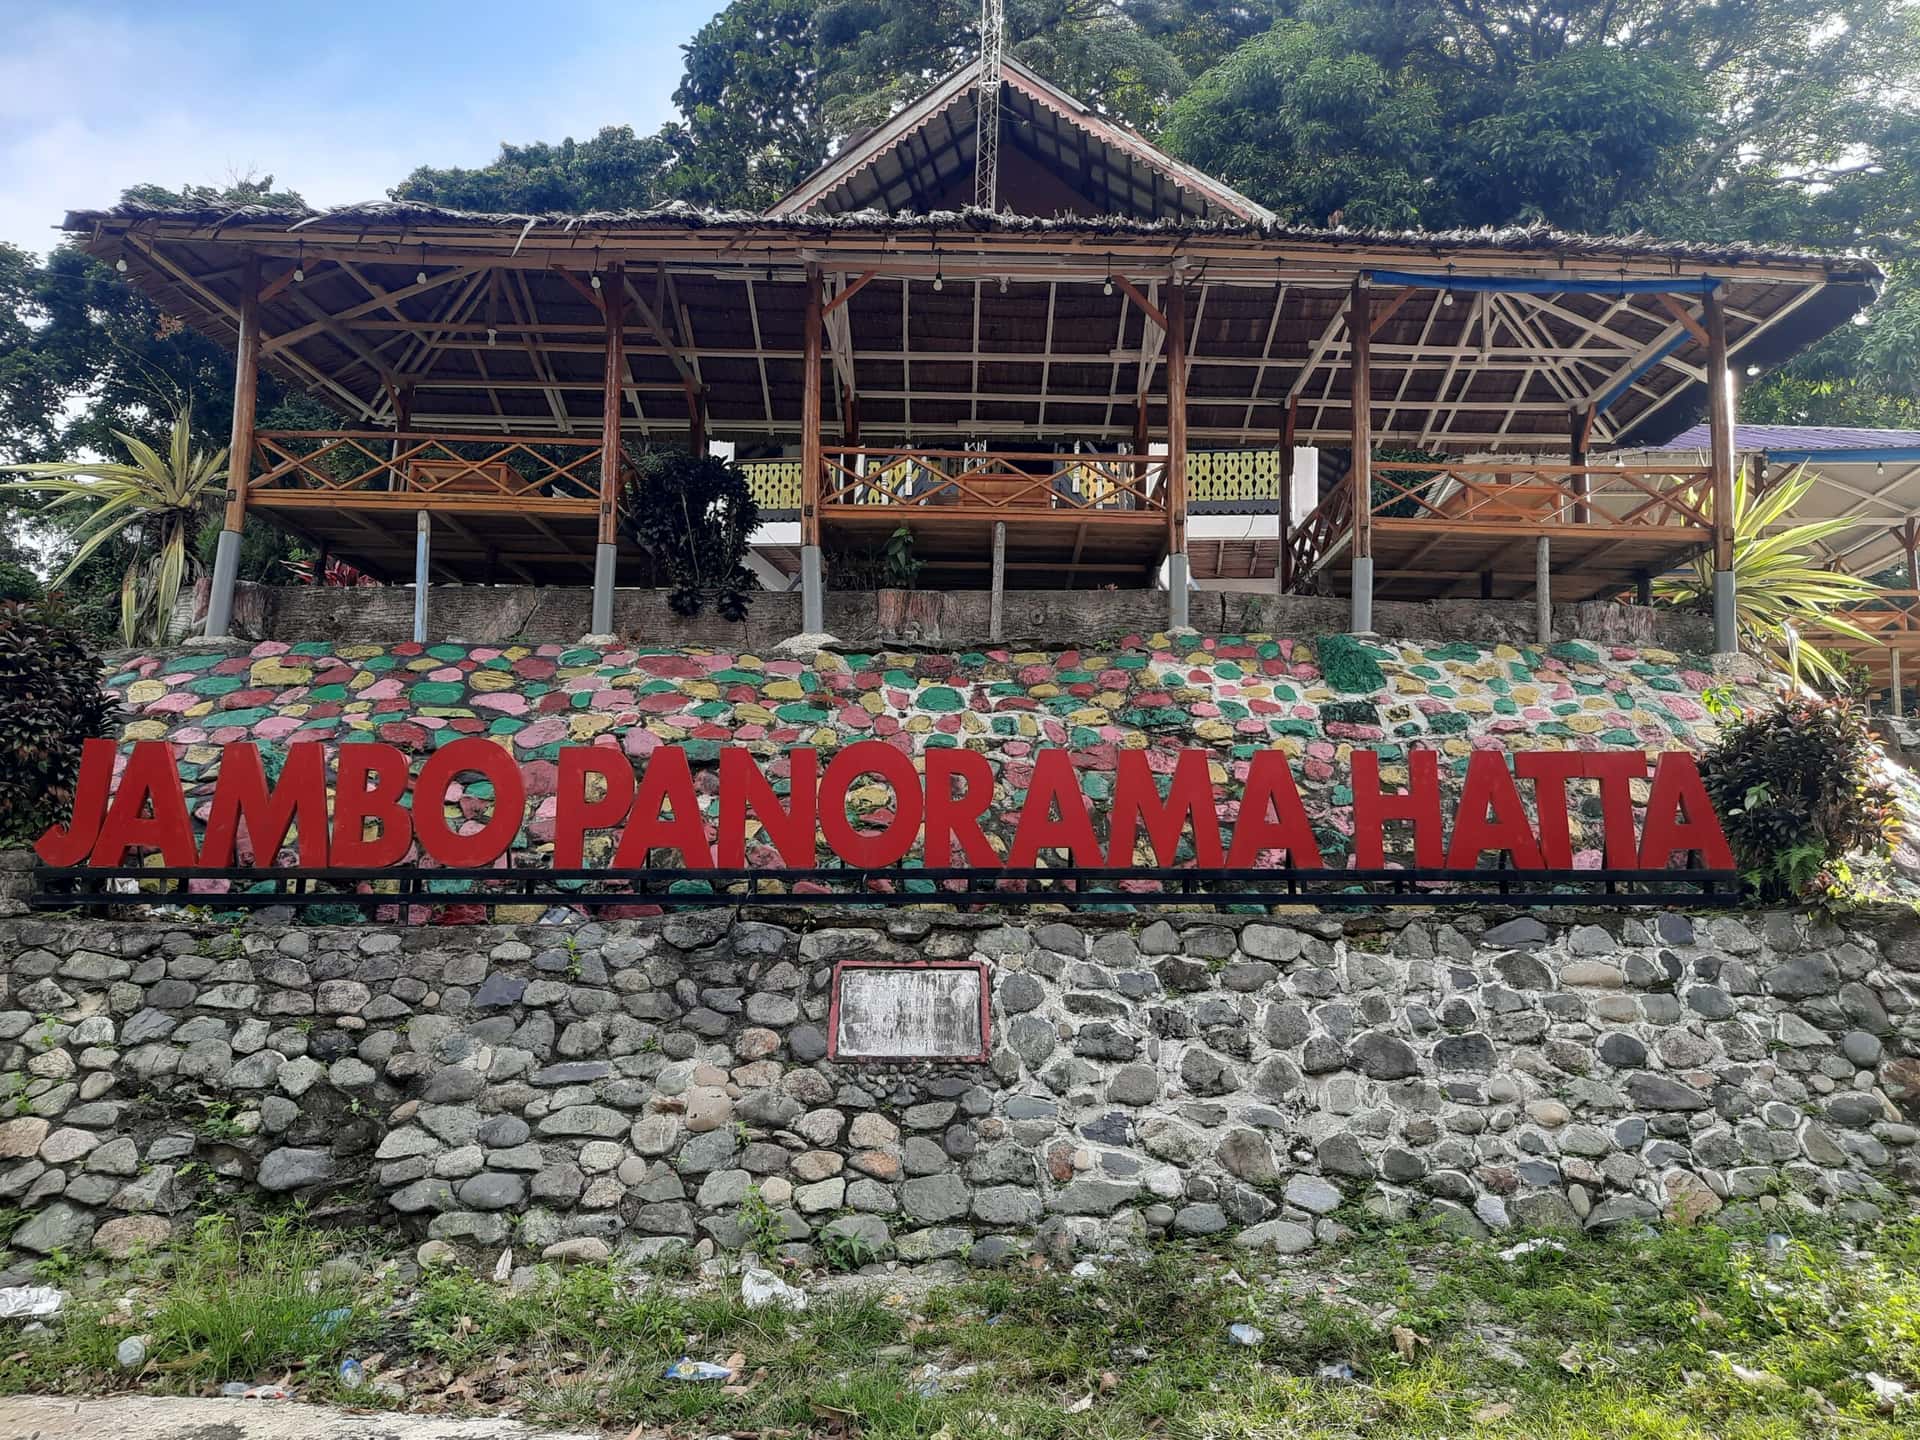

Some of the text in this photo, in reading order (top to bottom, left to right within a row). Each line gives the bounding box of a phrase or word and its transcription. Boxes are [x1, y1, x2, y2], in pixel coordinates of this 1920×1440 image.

[34, 738, 1736, 870] JAMBO PANORAMA HATTA
